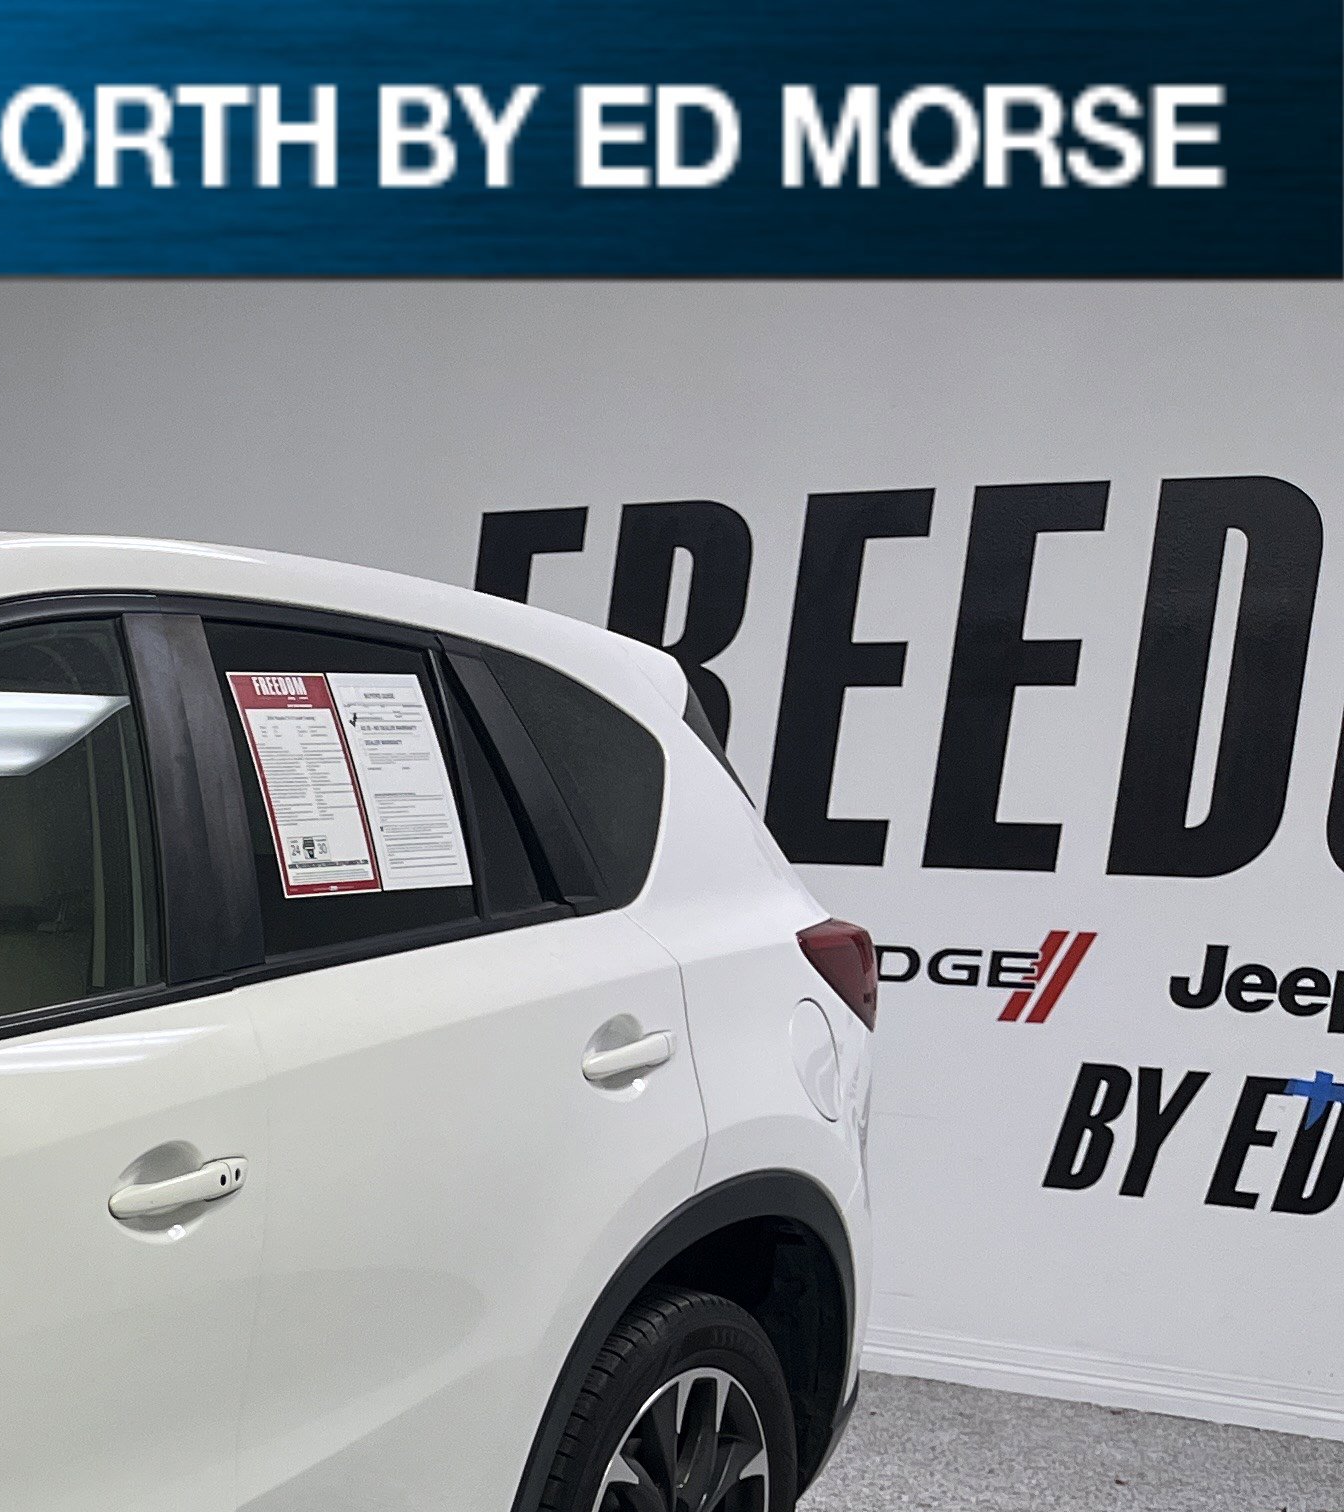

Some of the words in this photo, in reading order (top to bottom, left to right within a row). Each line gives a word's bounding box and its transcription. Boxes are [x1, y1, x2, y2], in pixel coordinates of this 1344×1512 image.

[251, 676, 308, 696] FREEDOM
[475, 475, 1344, 878] REED
[874, 944, 1040, 990] DGE
[1042, 1061, 1211, 1198] BY
